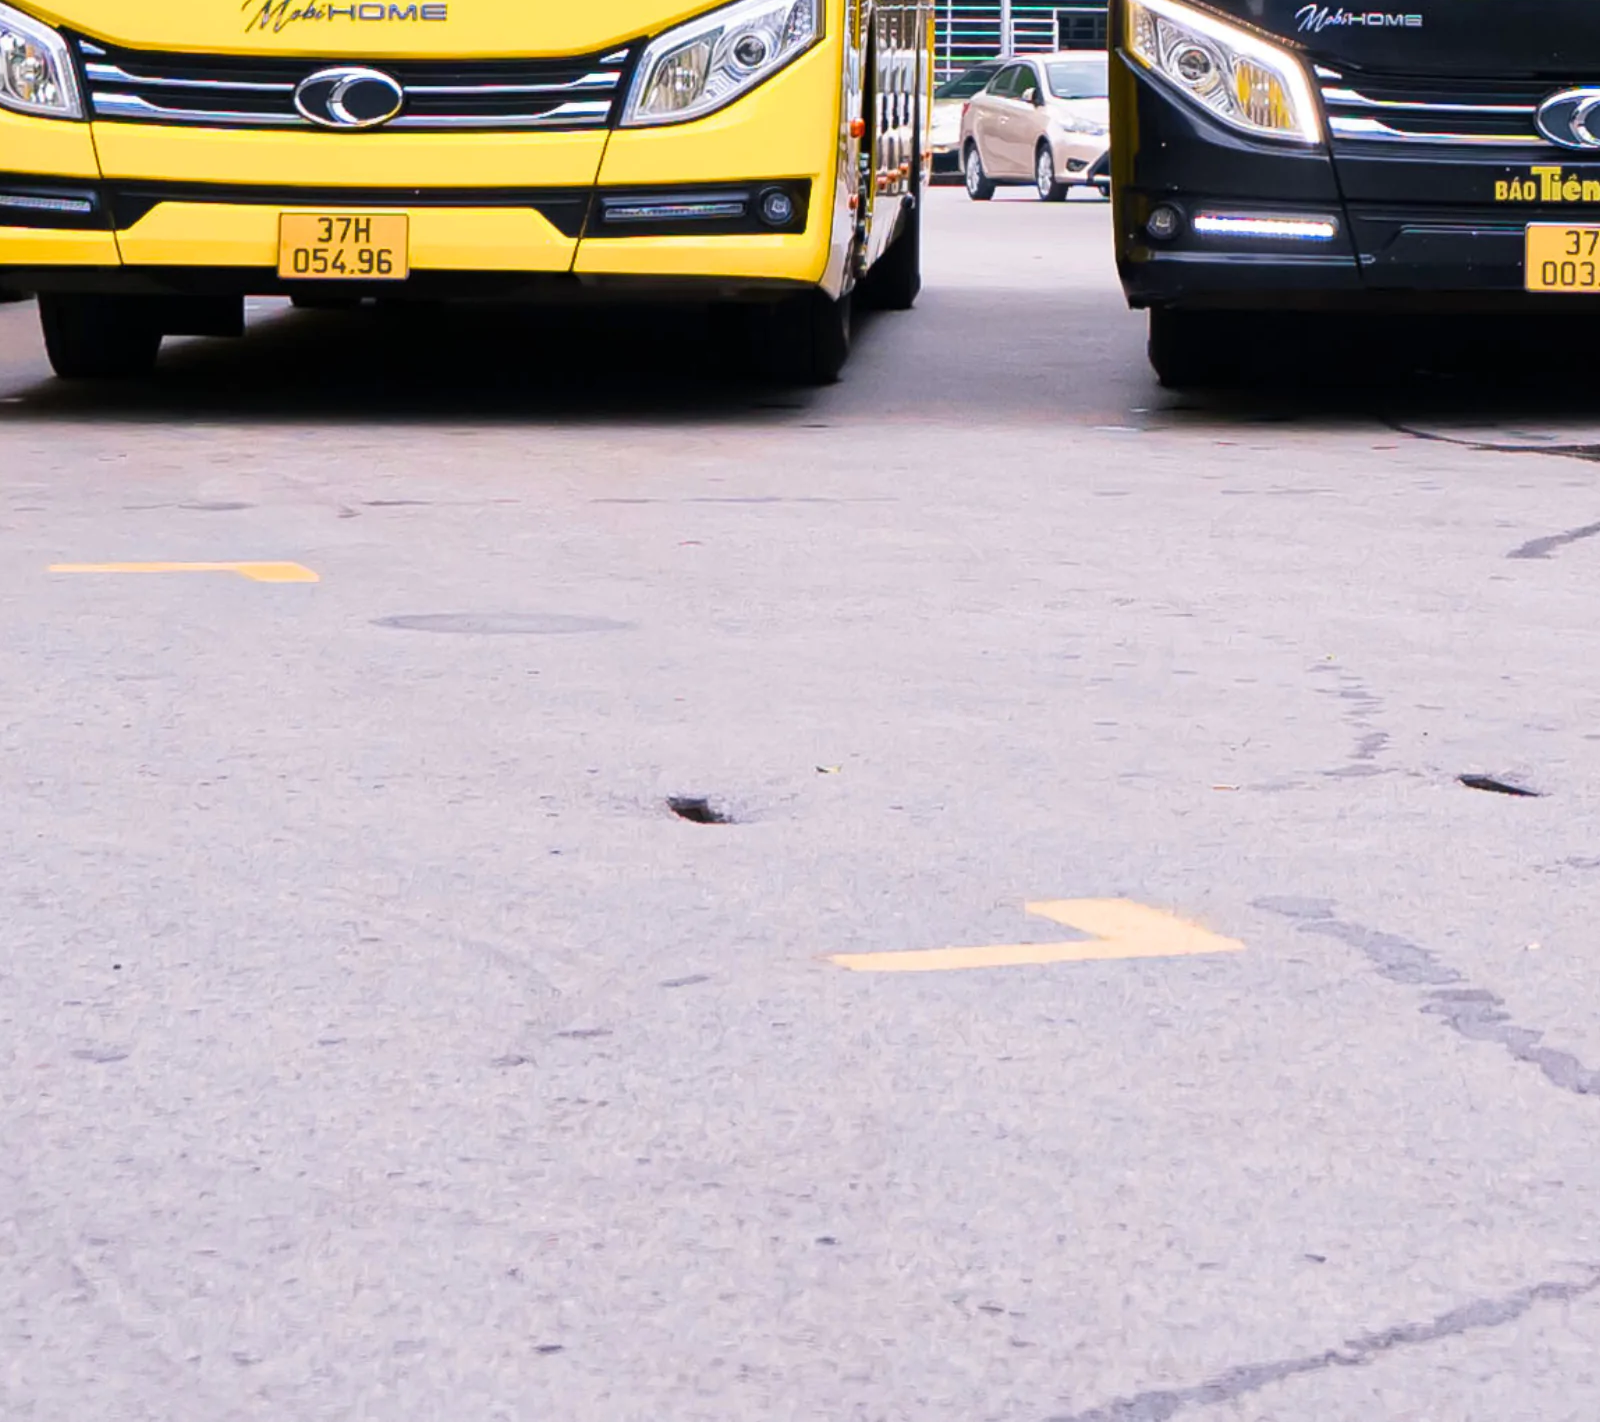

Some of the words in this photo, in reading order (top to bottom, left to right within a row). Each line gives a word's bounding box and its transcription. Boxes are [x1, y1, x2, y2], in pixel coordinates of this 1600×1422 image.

[1494, 176, 1536, 201] BÁO
[317, 217, 371, 244] 37H
[294, 248, 393, 274] 054.96
